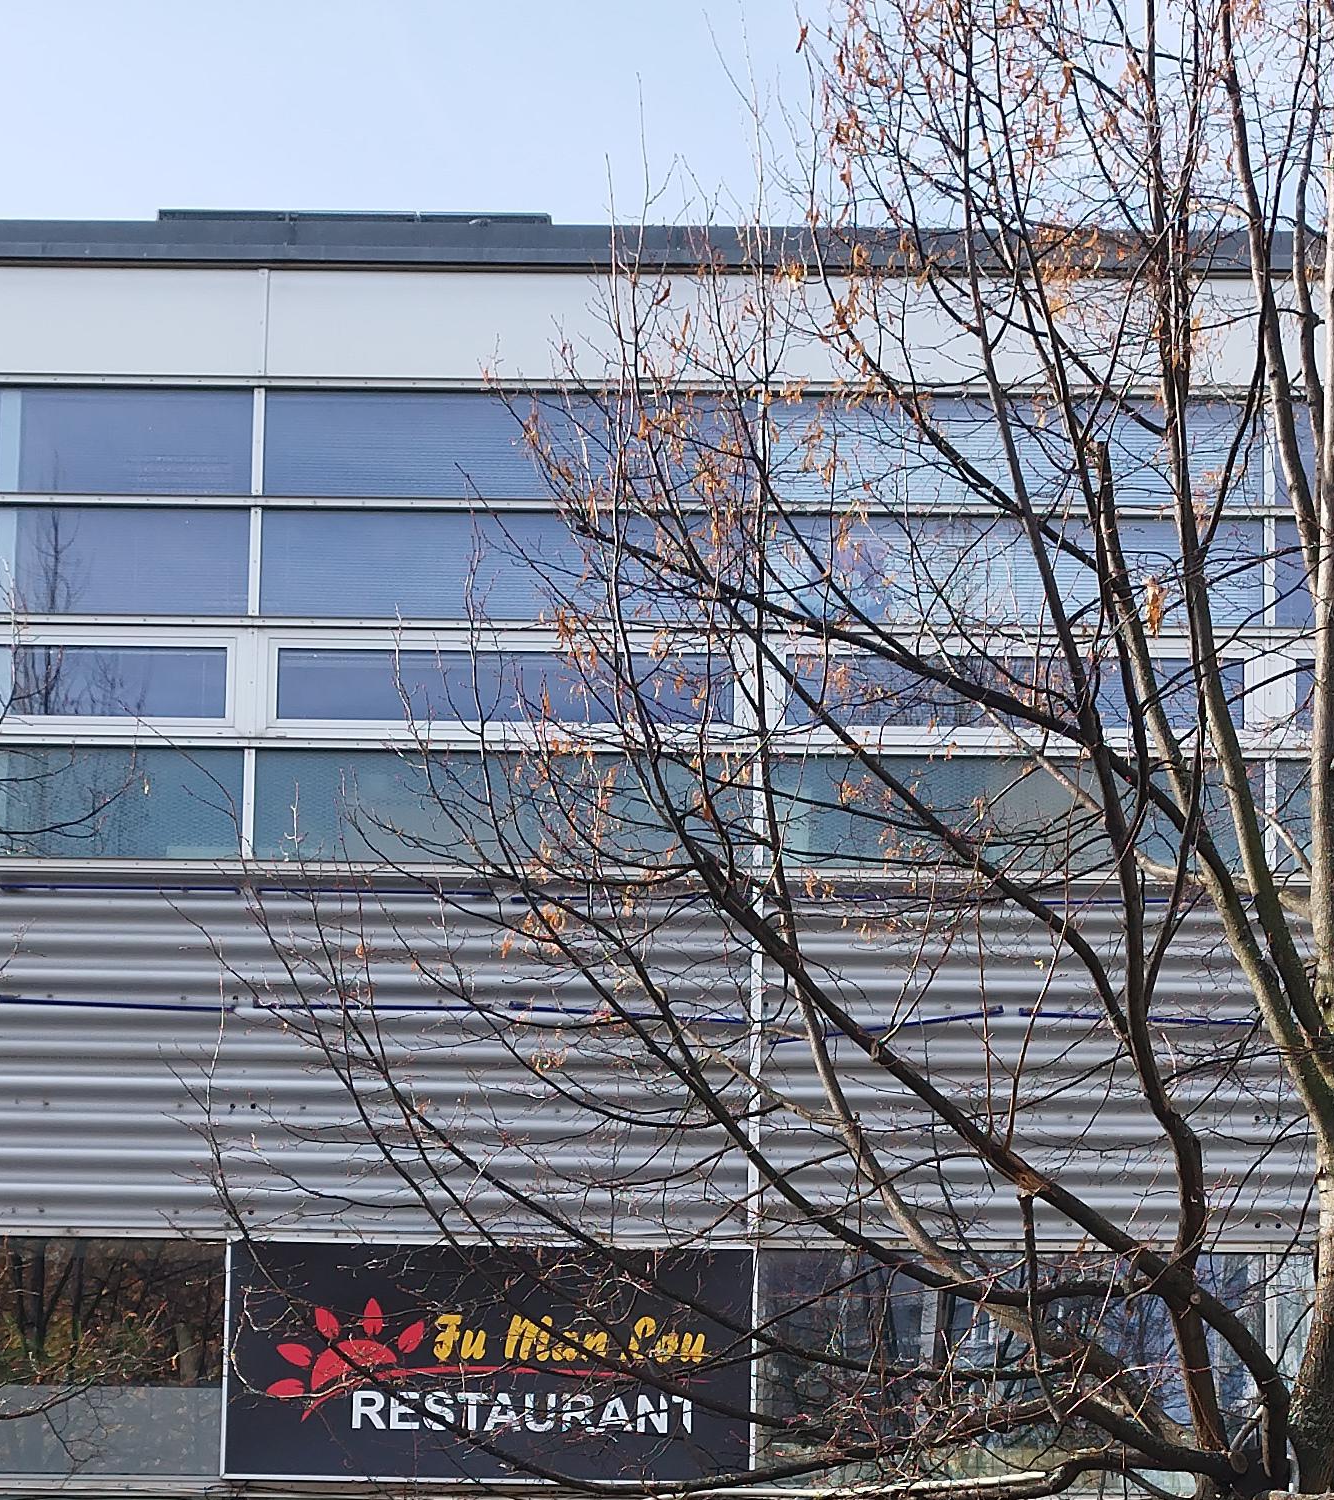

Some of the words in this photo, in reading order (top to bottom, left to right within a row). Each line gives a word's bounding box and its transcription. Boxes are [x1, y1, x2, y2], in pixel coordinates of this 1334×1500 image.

[432, 1313, 486, 1361] Fu
[504, 1313, 607, 1362] Man
[351, 1390, 693, 1435] RESTAURANT
